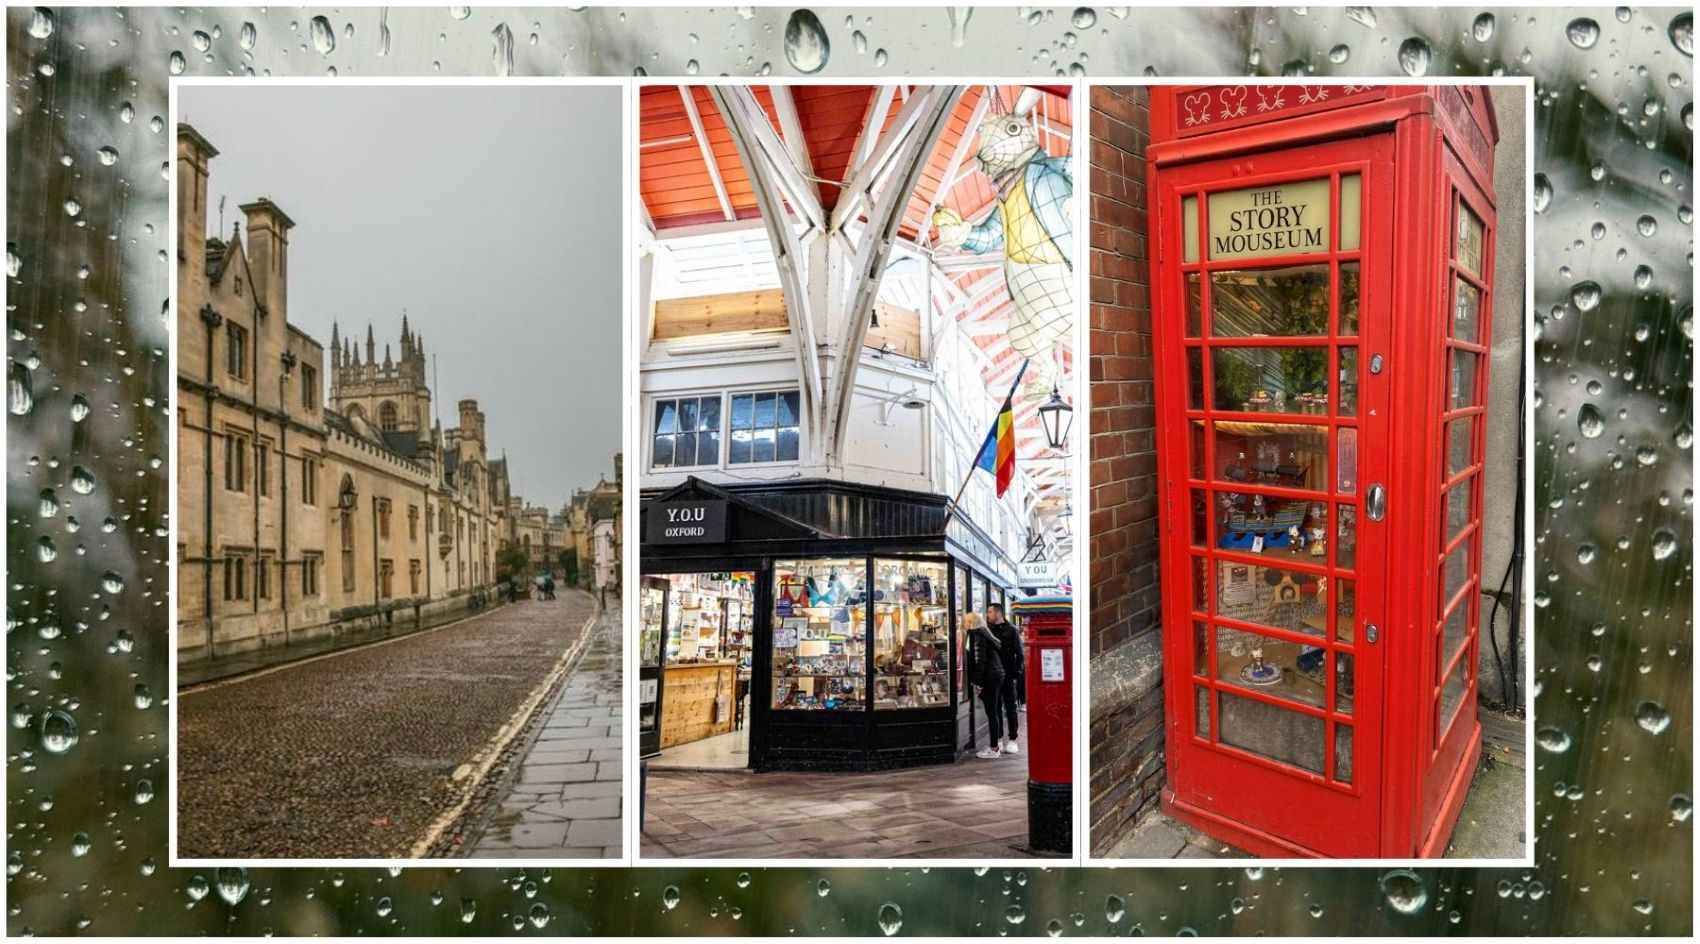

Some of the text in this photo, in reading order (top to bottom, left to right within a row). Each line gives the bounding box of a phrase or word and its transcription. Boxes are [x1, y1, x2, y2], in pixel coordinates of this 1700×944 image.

[1251, 190, 1282, 206] THE
[1230, 204, 1307, 232] STORY
[1214, 227, 1323, 254] MOUSEUM
[667, 508, 705, 522] Y.O.U
[665, 527, 705, 537] OXFORD
